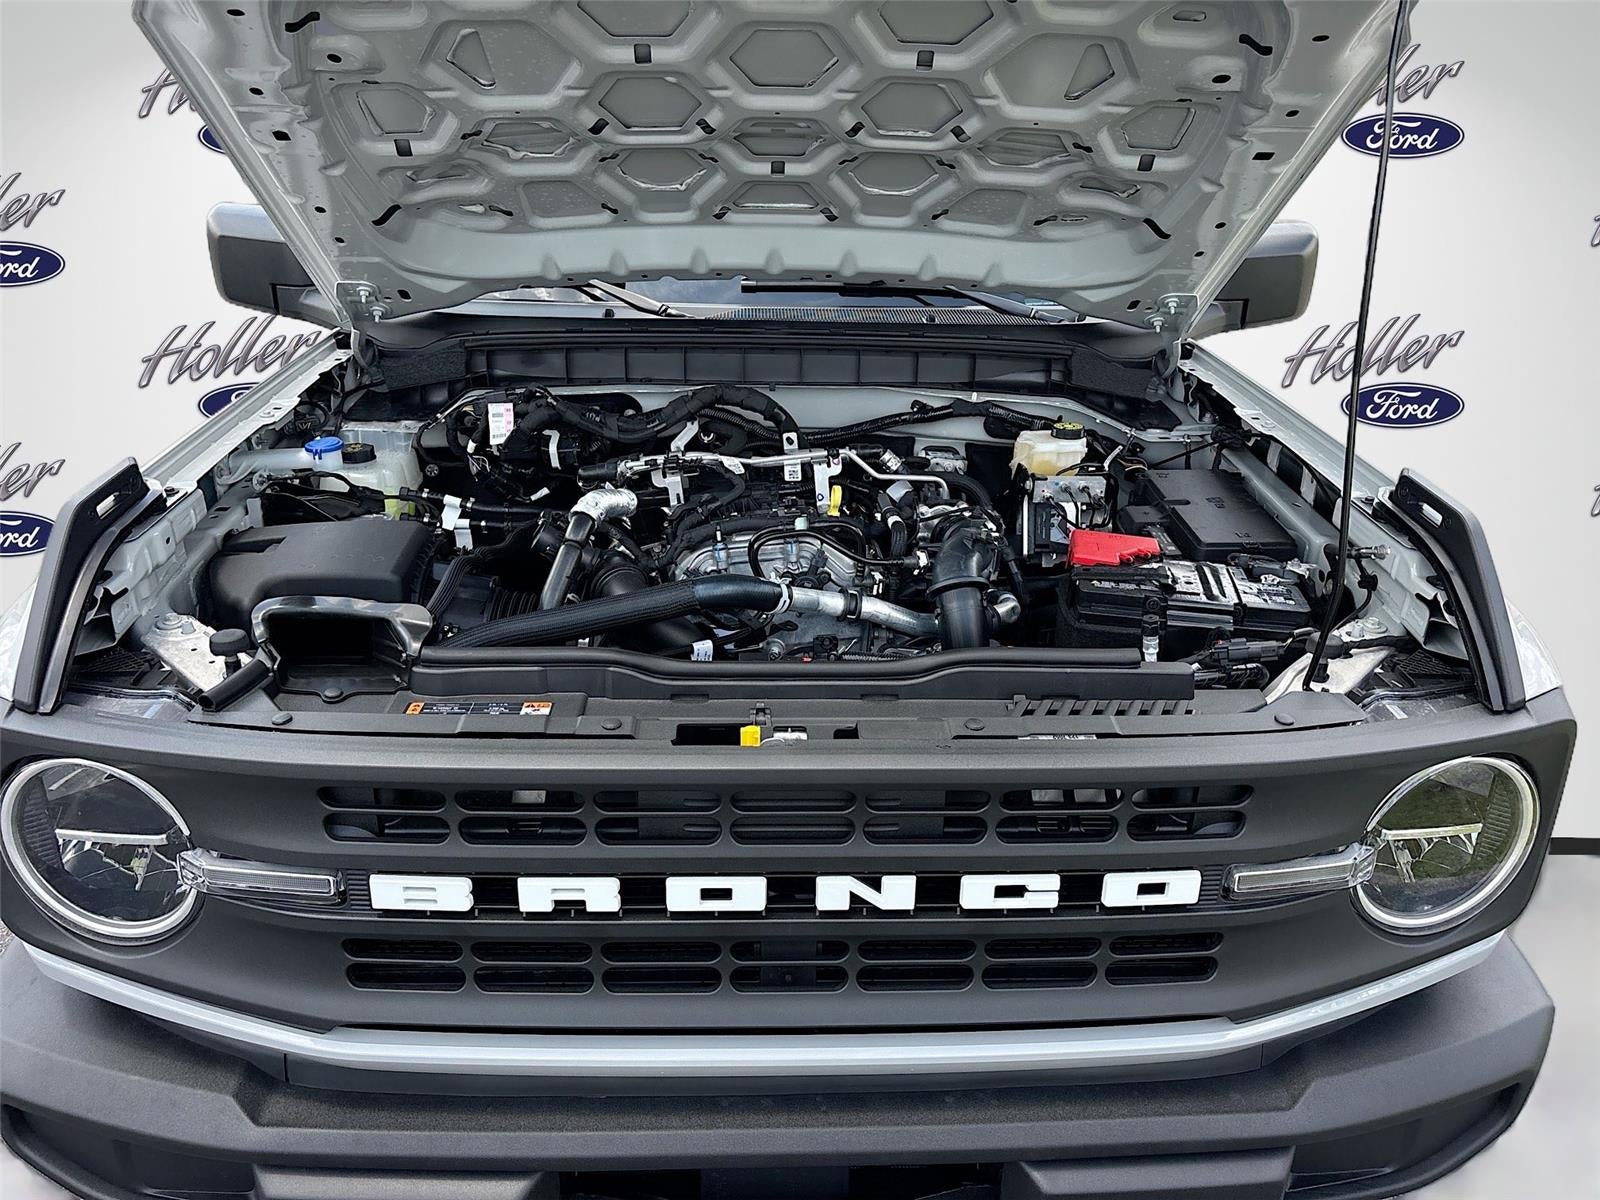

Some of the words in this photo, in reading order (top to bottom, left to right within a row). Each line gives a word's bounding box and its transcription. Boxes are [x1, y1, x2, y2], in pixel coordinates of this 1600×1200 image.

[1366, 120, 1440, 150] Ford
[138, 314, 323, 389] Holler
[1281, 313, 1465, 389] Holler
[1366, 389, 1440, 420] Ford
[369, 869, 1203, 914] BRONCO
